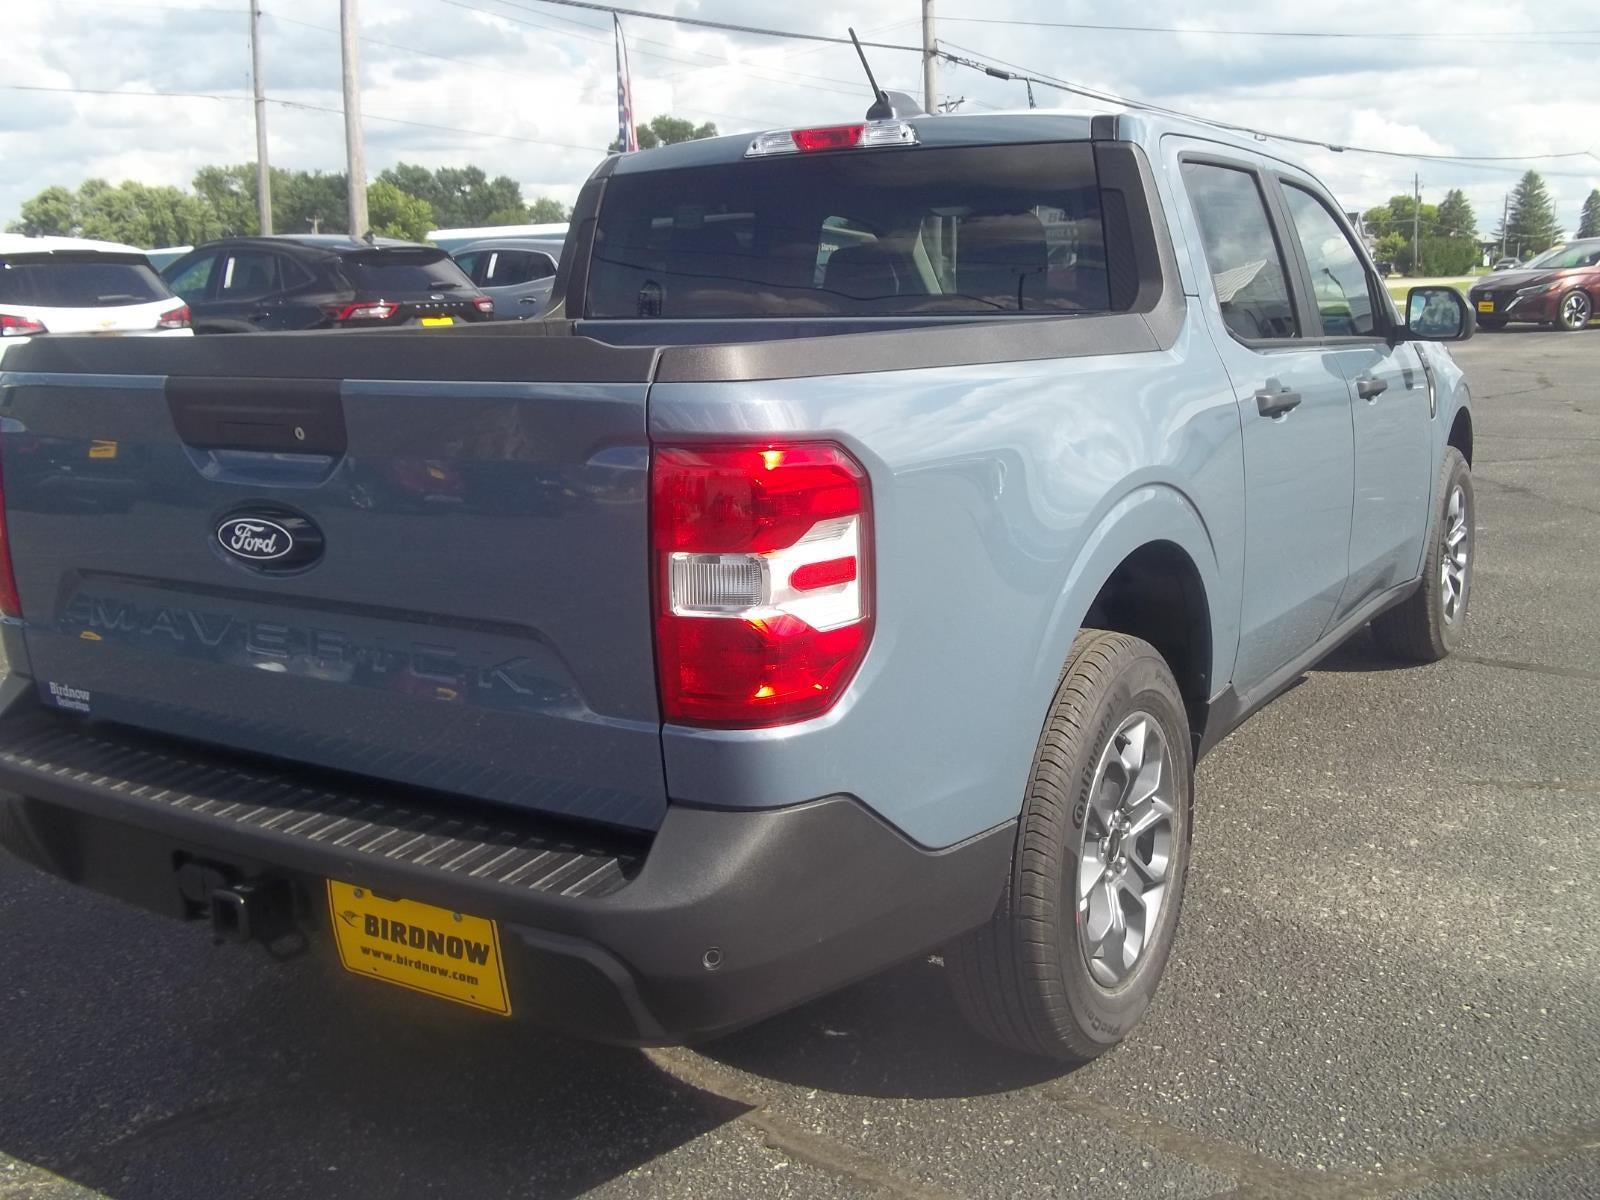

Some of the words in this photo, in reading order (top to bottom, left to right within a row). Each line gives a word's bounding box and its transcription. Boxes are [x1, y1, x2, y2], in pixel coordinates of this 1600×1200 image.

[231, 523, 277, 554] Ford
[49, 680, 90, 702] Birdnow
[364, 912, 491, 967] BIRDNOW
[360, 944, 480, 986] www.birdnow.com
